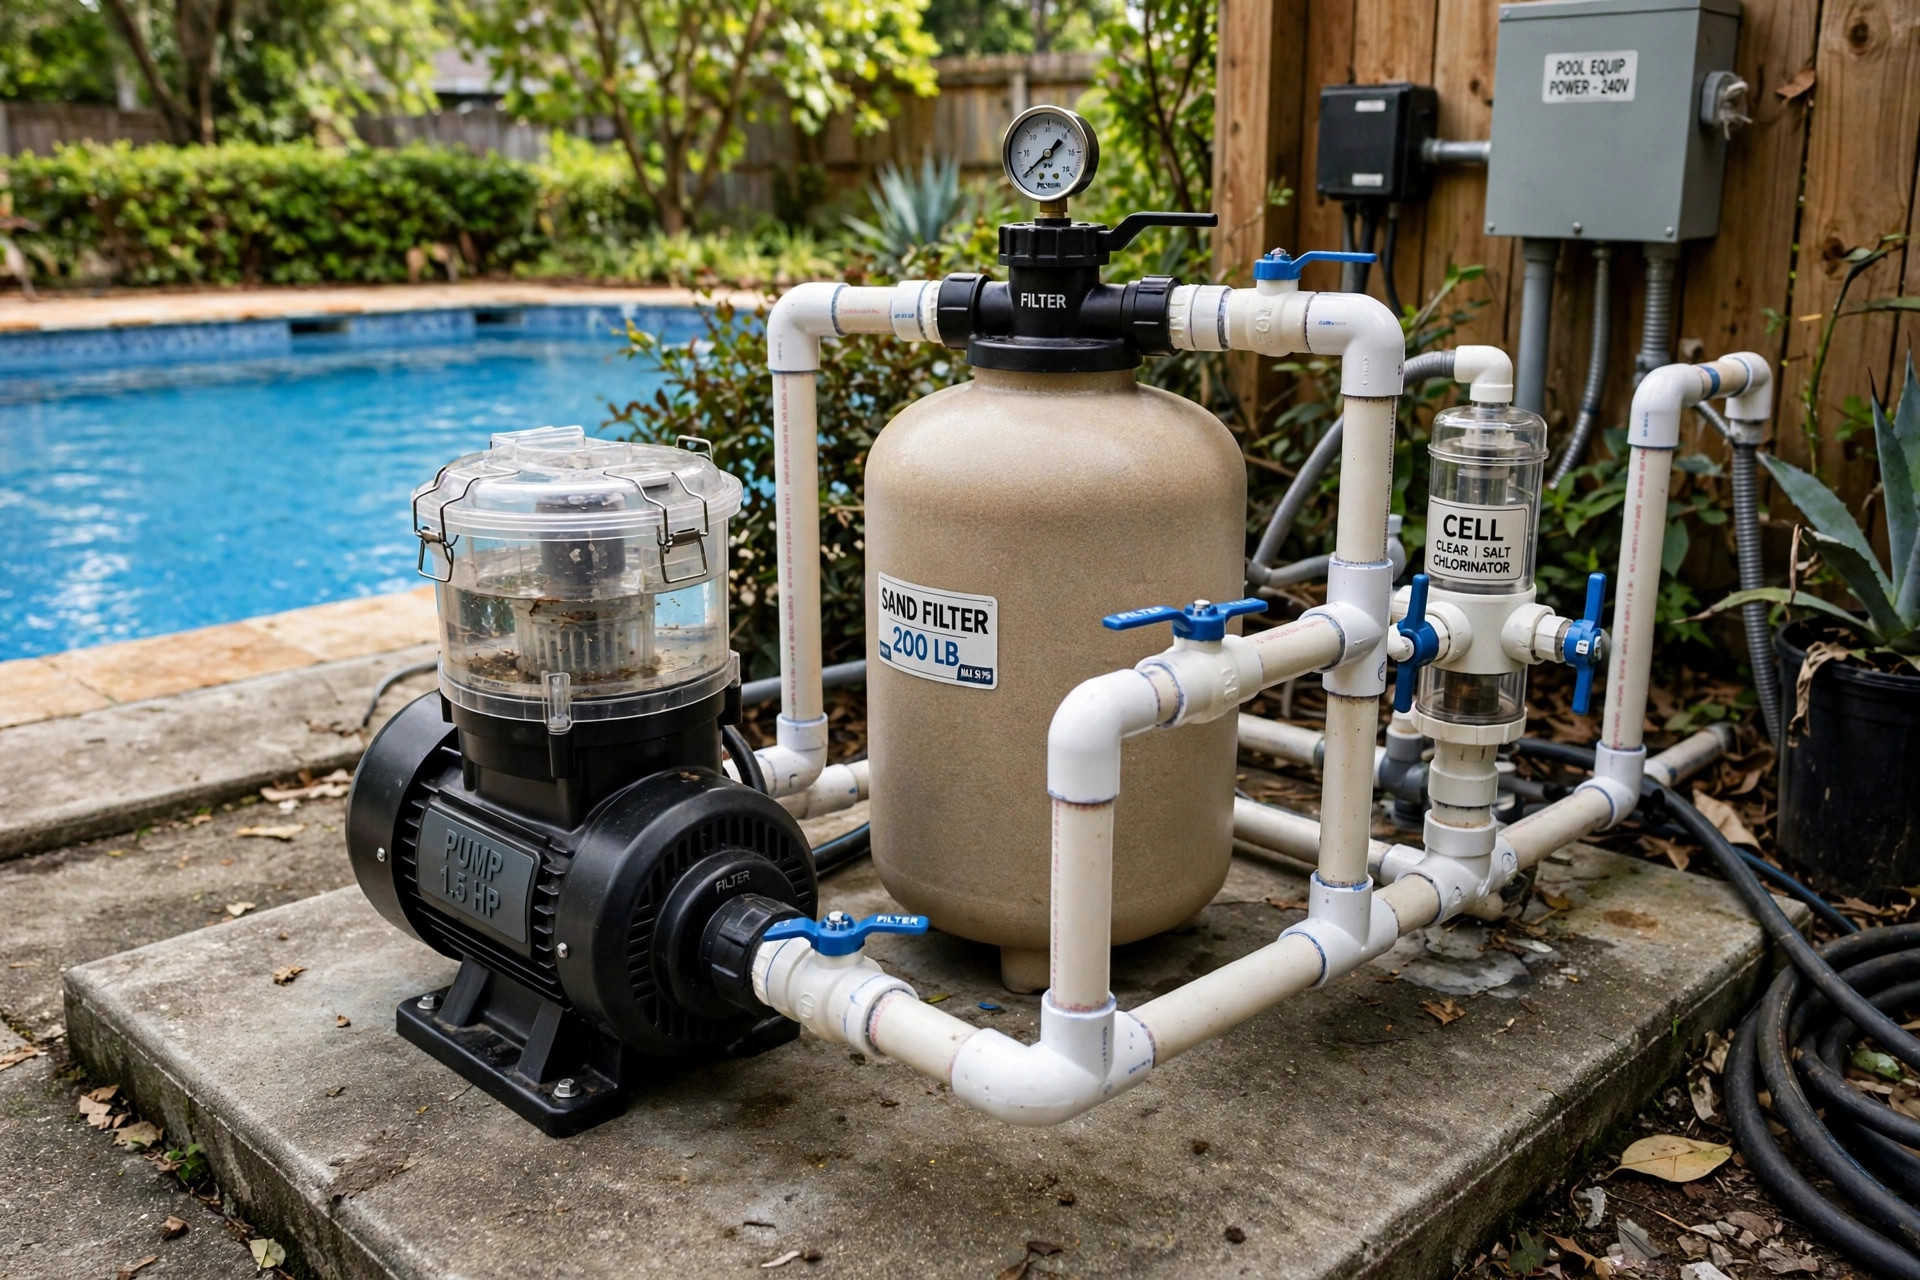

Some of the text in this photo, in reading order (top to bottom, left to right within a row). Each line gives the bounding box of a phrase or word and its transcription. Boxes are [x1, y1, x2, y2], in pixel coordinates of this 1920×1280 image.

[1556, 58, 1626, 76] POOL EQUIP
[1549, 80, 1590, 95] POWER
[1601, 78, 1630, 94] 240V
[1020, 292, 1067, 309] FILTER
[1443, 514, 1504, 541] CELL
[1436, 540, 1468, 557] CLEAR
[1483, 547, 1511, 558] SALT
[1433, 554, 1510, 574] CHLORINATOR
[881, 587, 989, 634] SAND FILTER
[893, 625, 960, 667] 200 LB
[444, 828, 504, 882] PUMP
[440, 864, 501, 919] 1.5 HP
[715, 870, 751, 895] FILTER
[876, 915, 918, 926] FILTER
